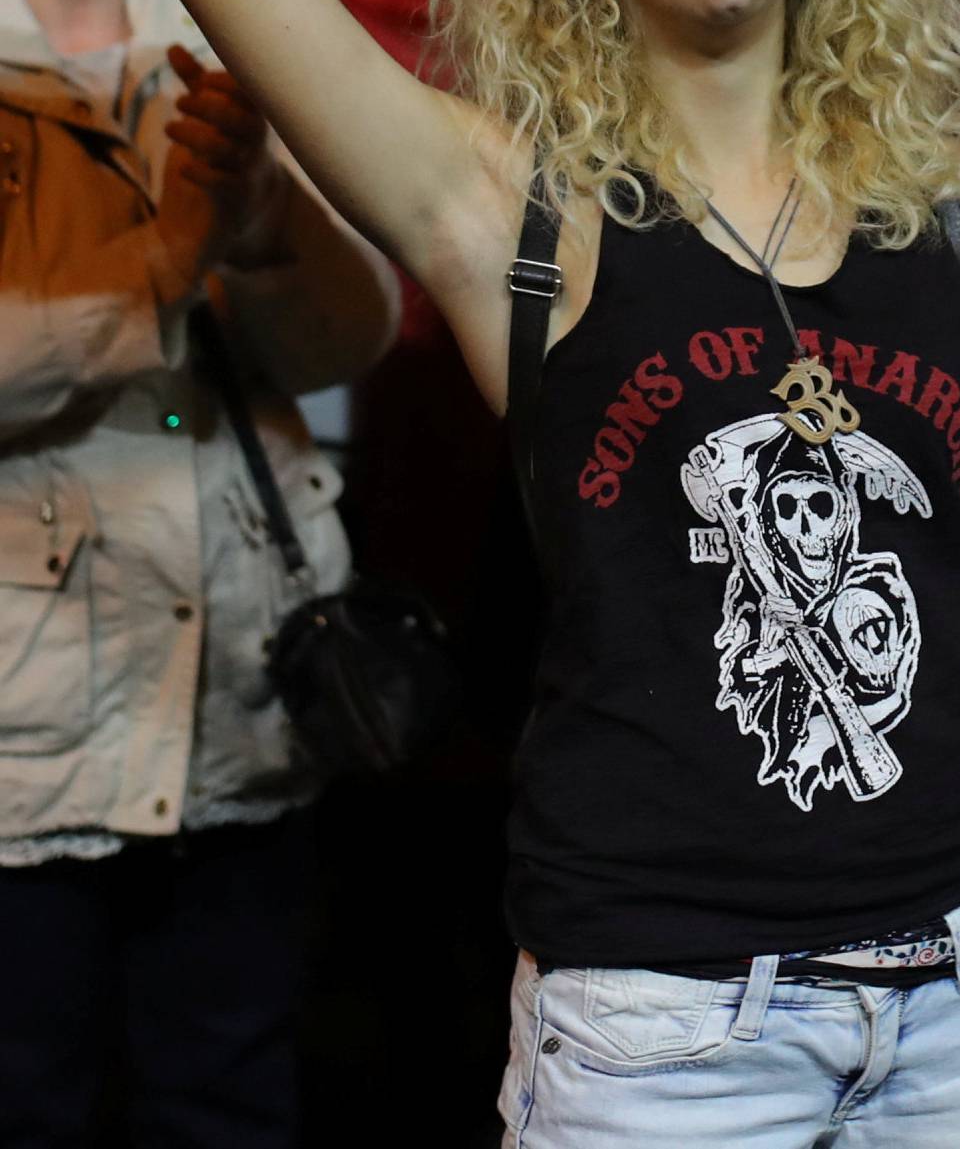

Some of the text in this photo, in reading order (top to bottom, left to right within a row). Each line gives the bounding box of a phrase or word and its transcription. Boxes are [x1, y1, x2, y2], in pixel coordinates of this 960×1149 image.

[578, 351, 684, 508] SONS
[688, 327, 764, 380] OF
[694, 532, 726, 558] MC
